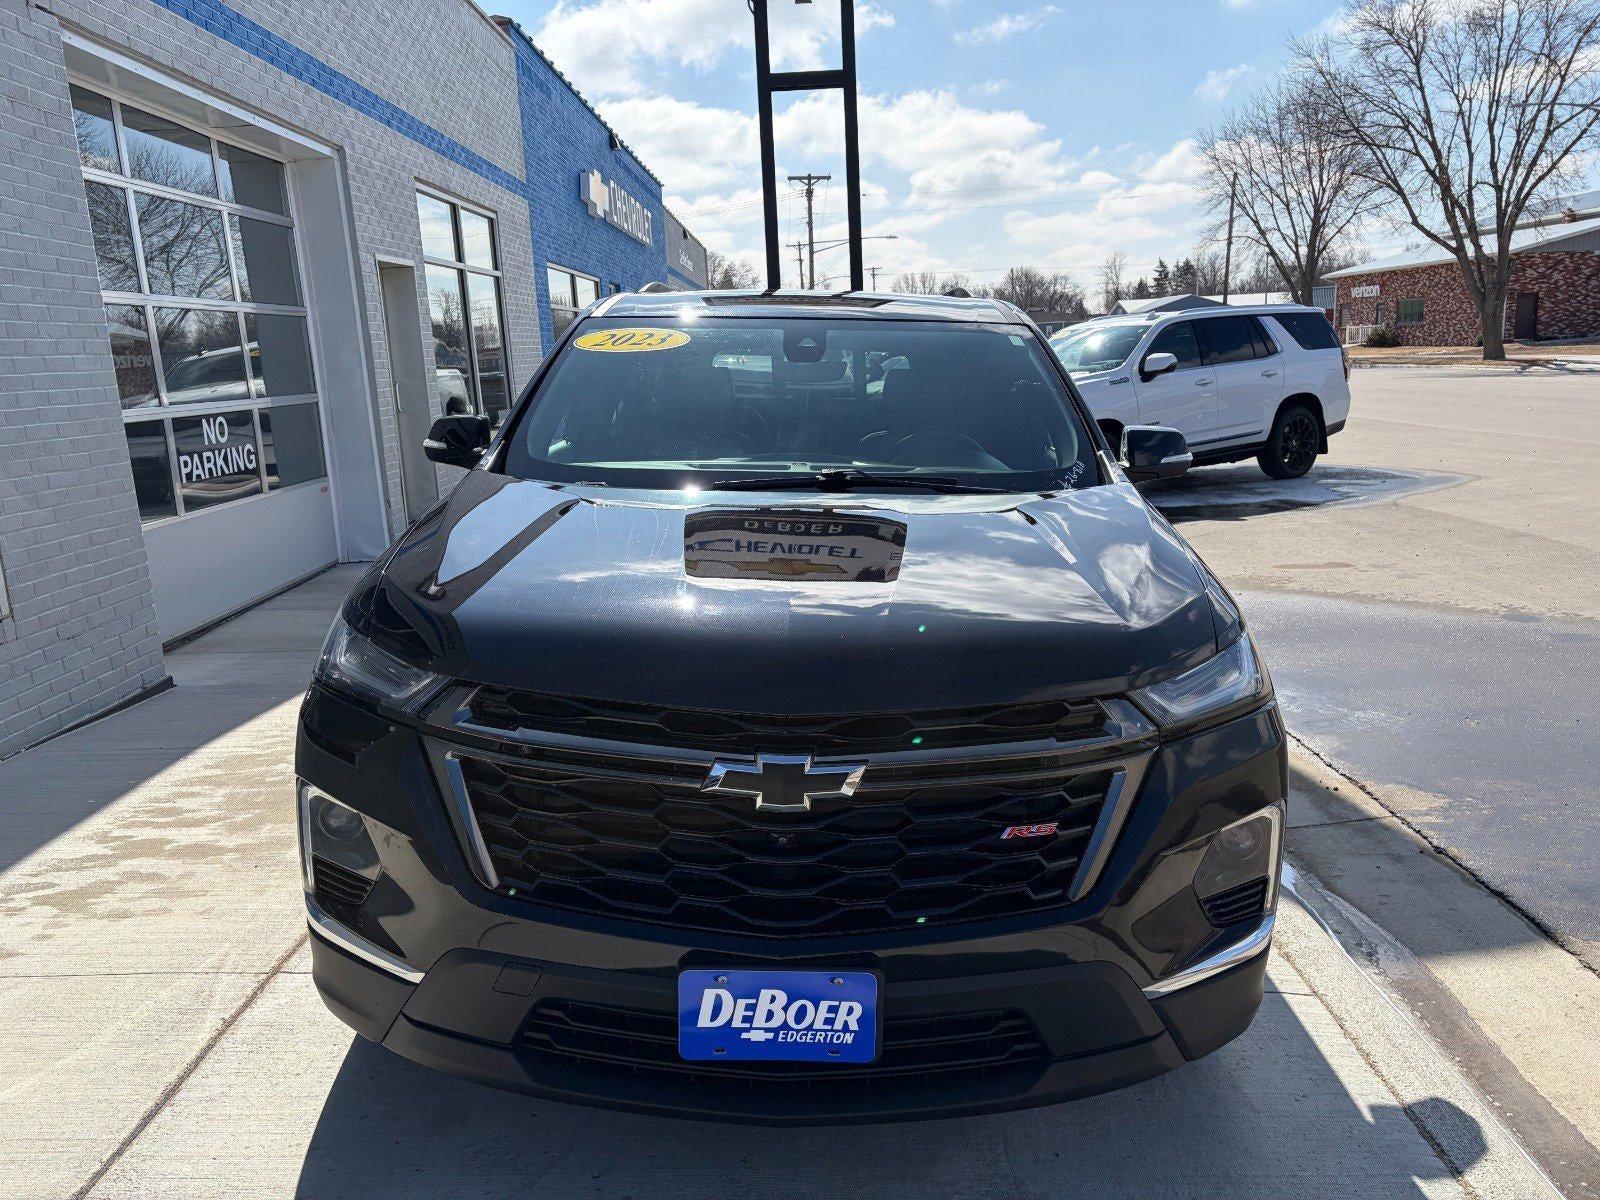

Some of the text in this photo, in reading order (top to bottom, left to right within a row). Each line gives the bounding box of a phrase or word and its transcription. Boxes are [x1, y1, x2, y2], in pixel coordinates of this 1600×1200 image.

[609, 179, 653, 245] CHEVROLET
[1351, 284, 1380, 298] verizon
[588, 332, 674, 348] 2023
[202, 416, 228, 446] NO
[179, 444, 257, 484] PARKING
[1000, 822, 1059, 839] RS
[778, 1031, 854, 1044] EDGERTON
